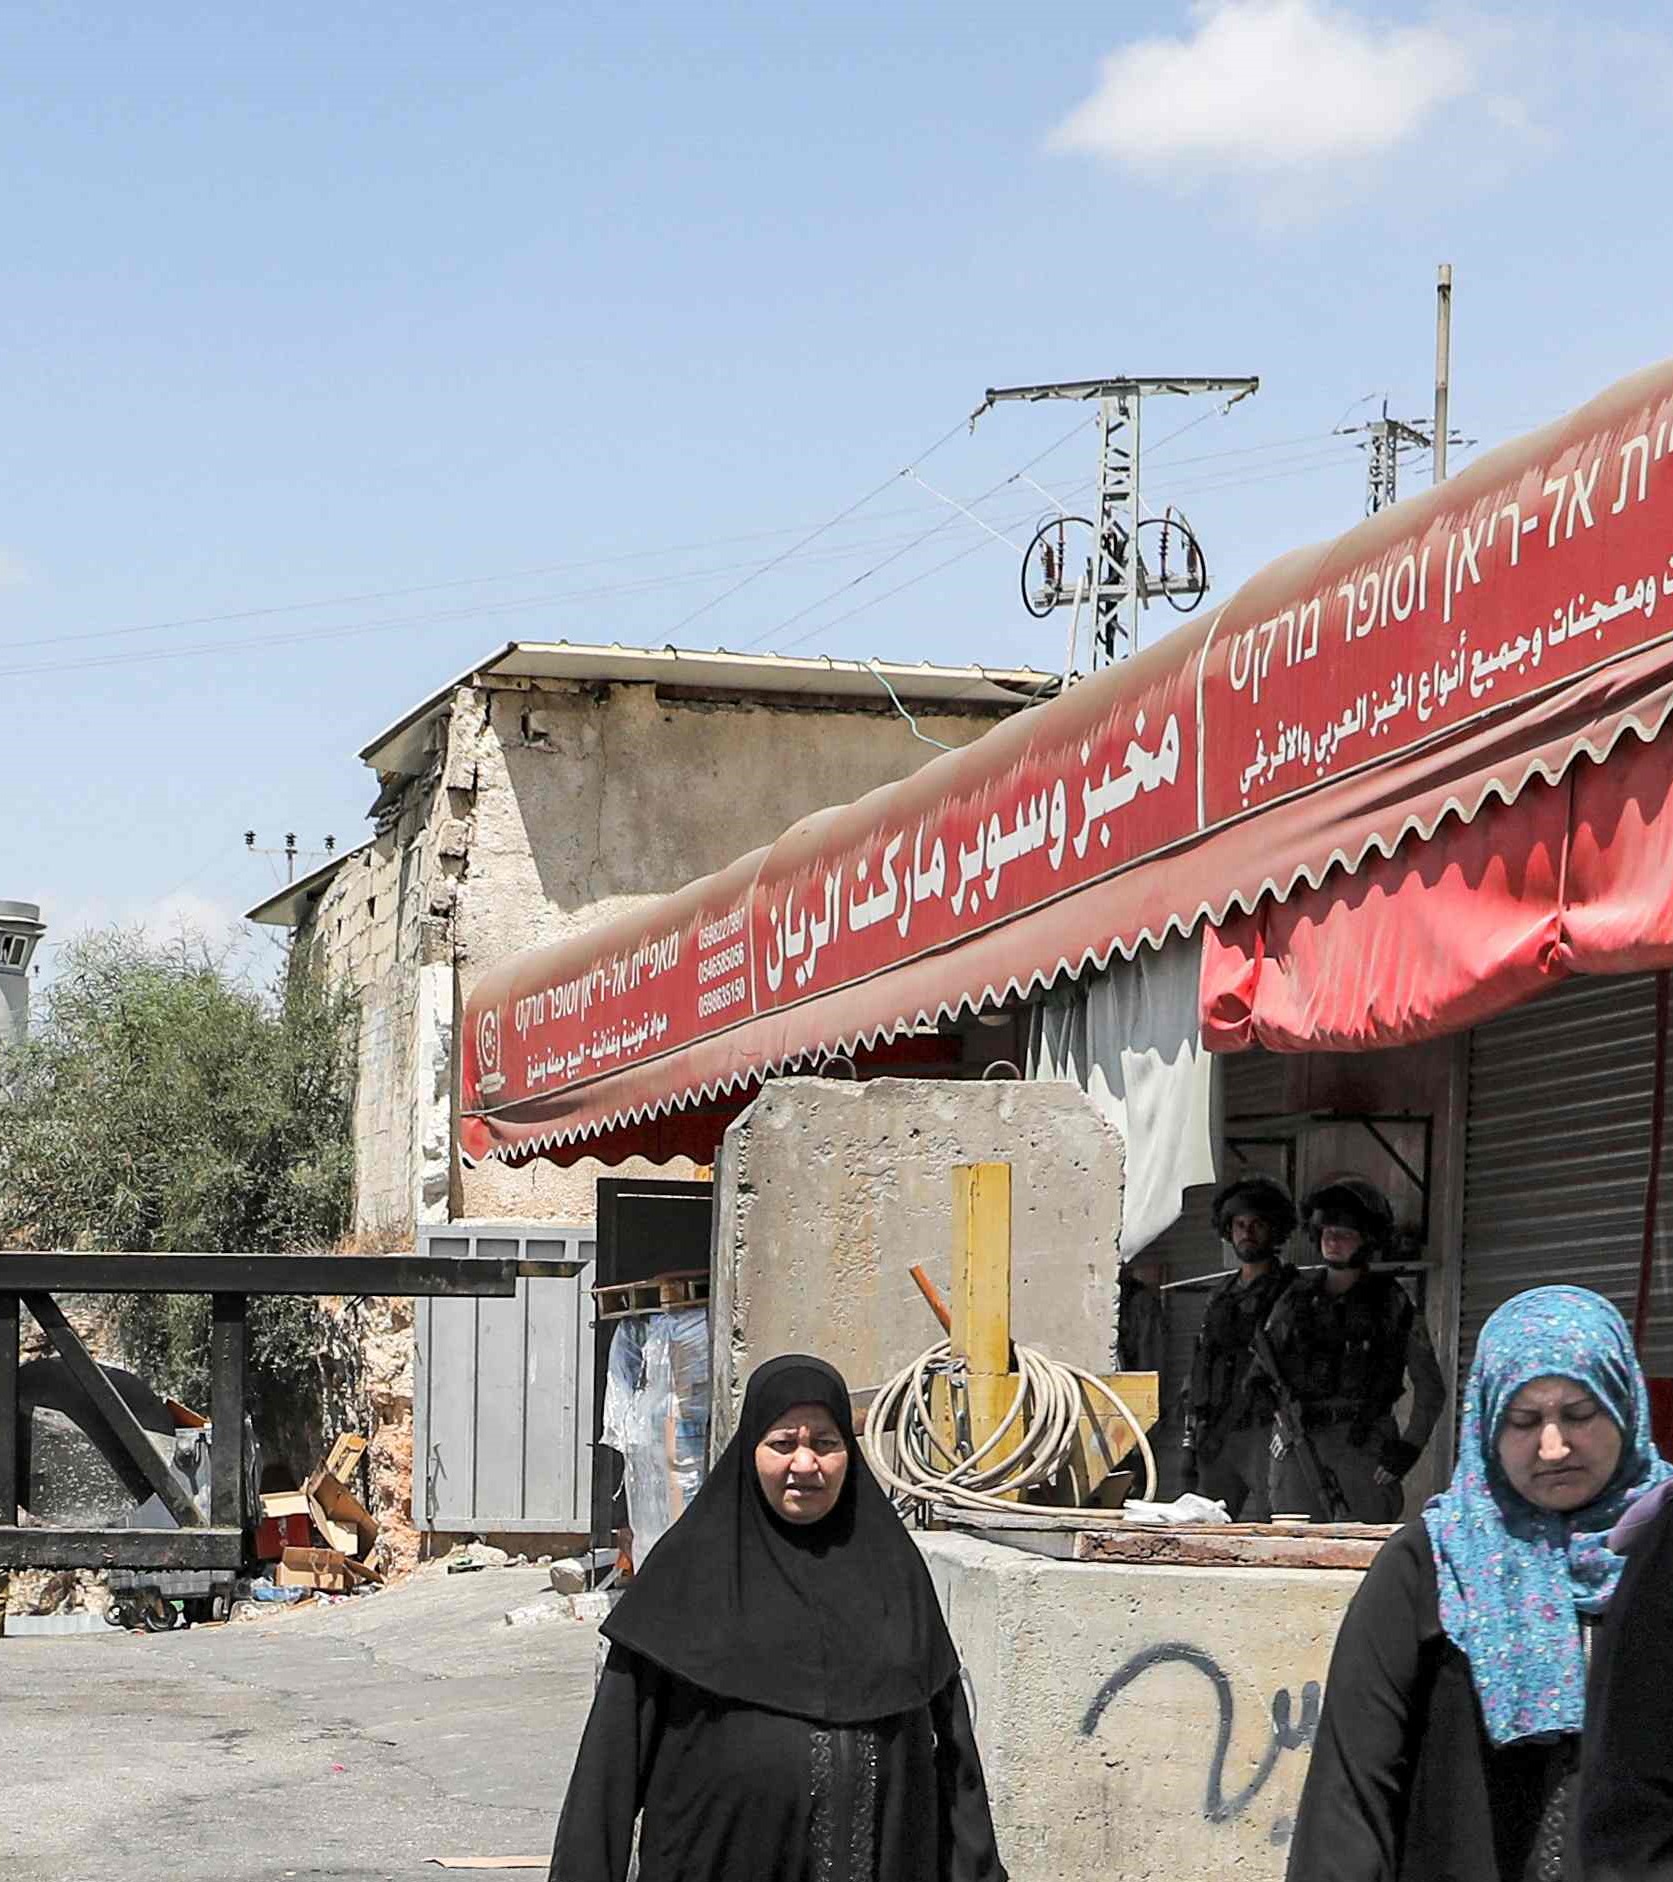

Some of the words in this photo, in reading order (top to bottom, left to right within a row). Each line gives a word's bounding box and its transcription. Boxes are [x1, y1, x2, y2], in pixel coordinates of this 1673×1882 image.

[1443, 458, 1601, 624] אל-ריאן
[1337, 546, 1430, 642] וסופר
[1548, 575, 1657, 646] ومعجنات
[1230, 598, 1321, 703] מרקט
[1417, 629, 1467, 721] أنواع
[1470, 627, 1542, 698] وجميع
[1314, 693, 1367, 776] العربي
[1369, 672, 1414, 737] الخبز
[1073, 710, 1180, 858] مخبز
[849, 815, 945, 937] ماركت
[952, 779, 1066, 916] وسوبر
[630, 931, 679, 989] מאפיית
[766, 866, 842, 991] الريان
[515, 993, 544, 1041] מרקט
